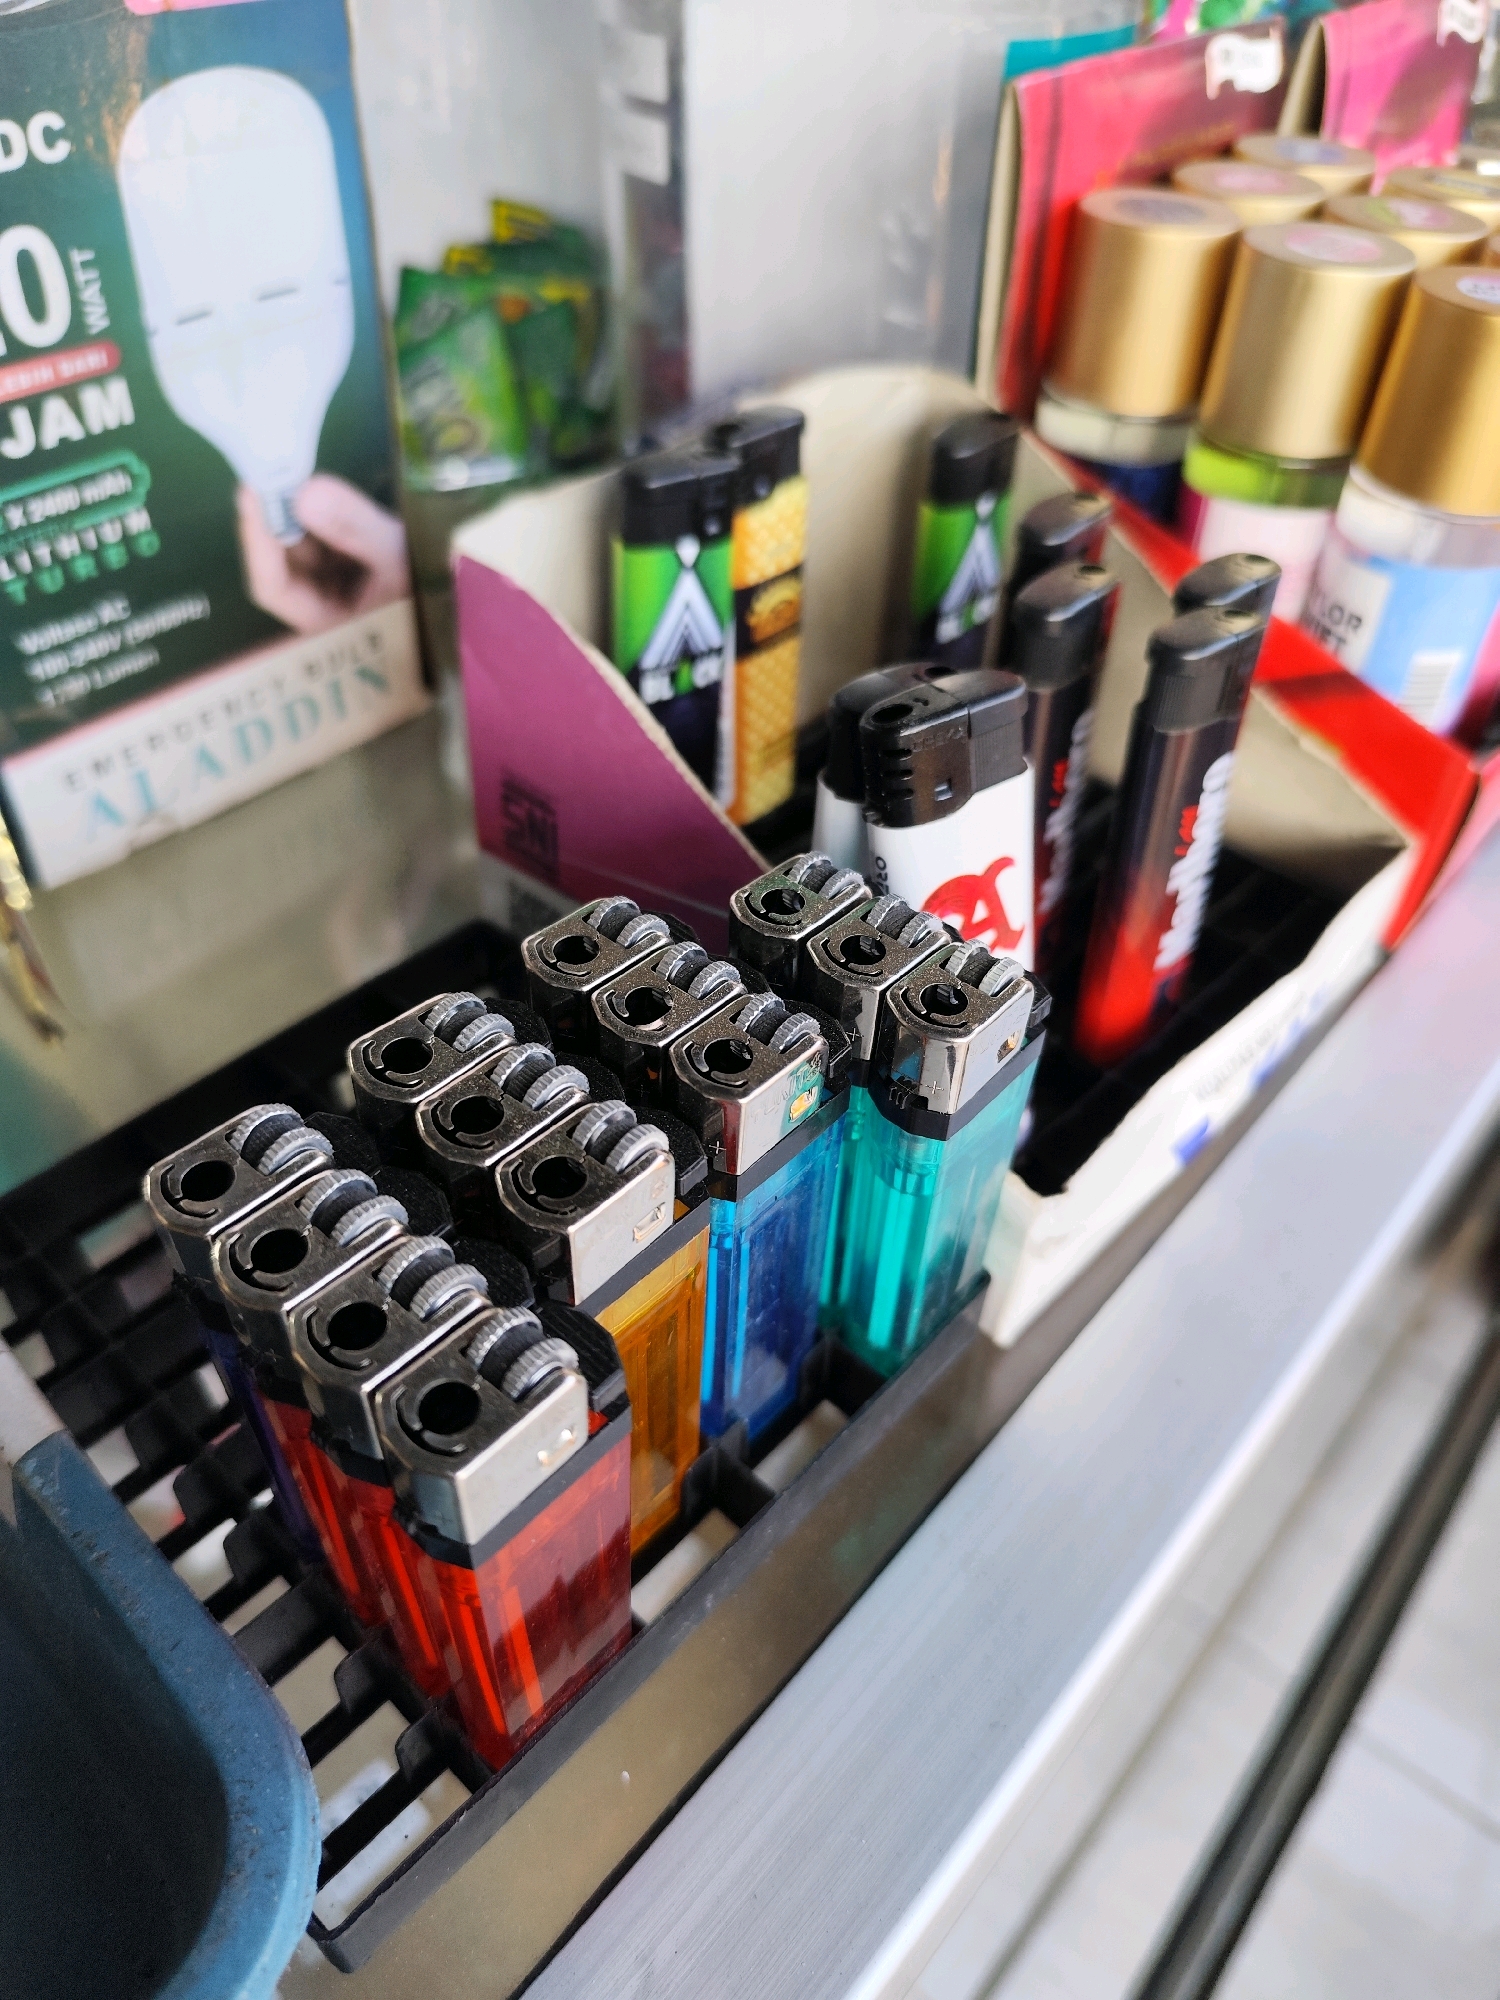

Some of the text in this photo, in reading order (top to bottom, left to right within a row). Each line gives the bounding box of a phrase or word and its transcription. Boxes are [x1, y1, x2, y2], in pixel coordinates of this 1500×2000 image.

[0, 225, 72, 357] 0
[69, 248, 110, 335] WATT
[0, 376, 136, 460] JAM
[77, 662, 392, 845] ALADDIN
